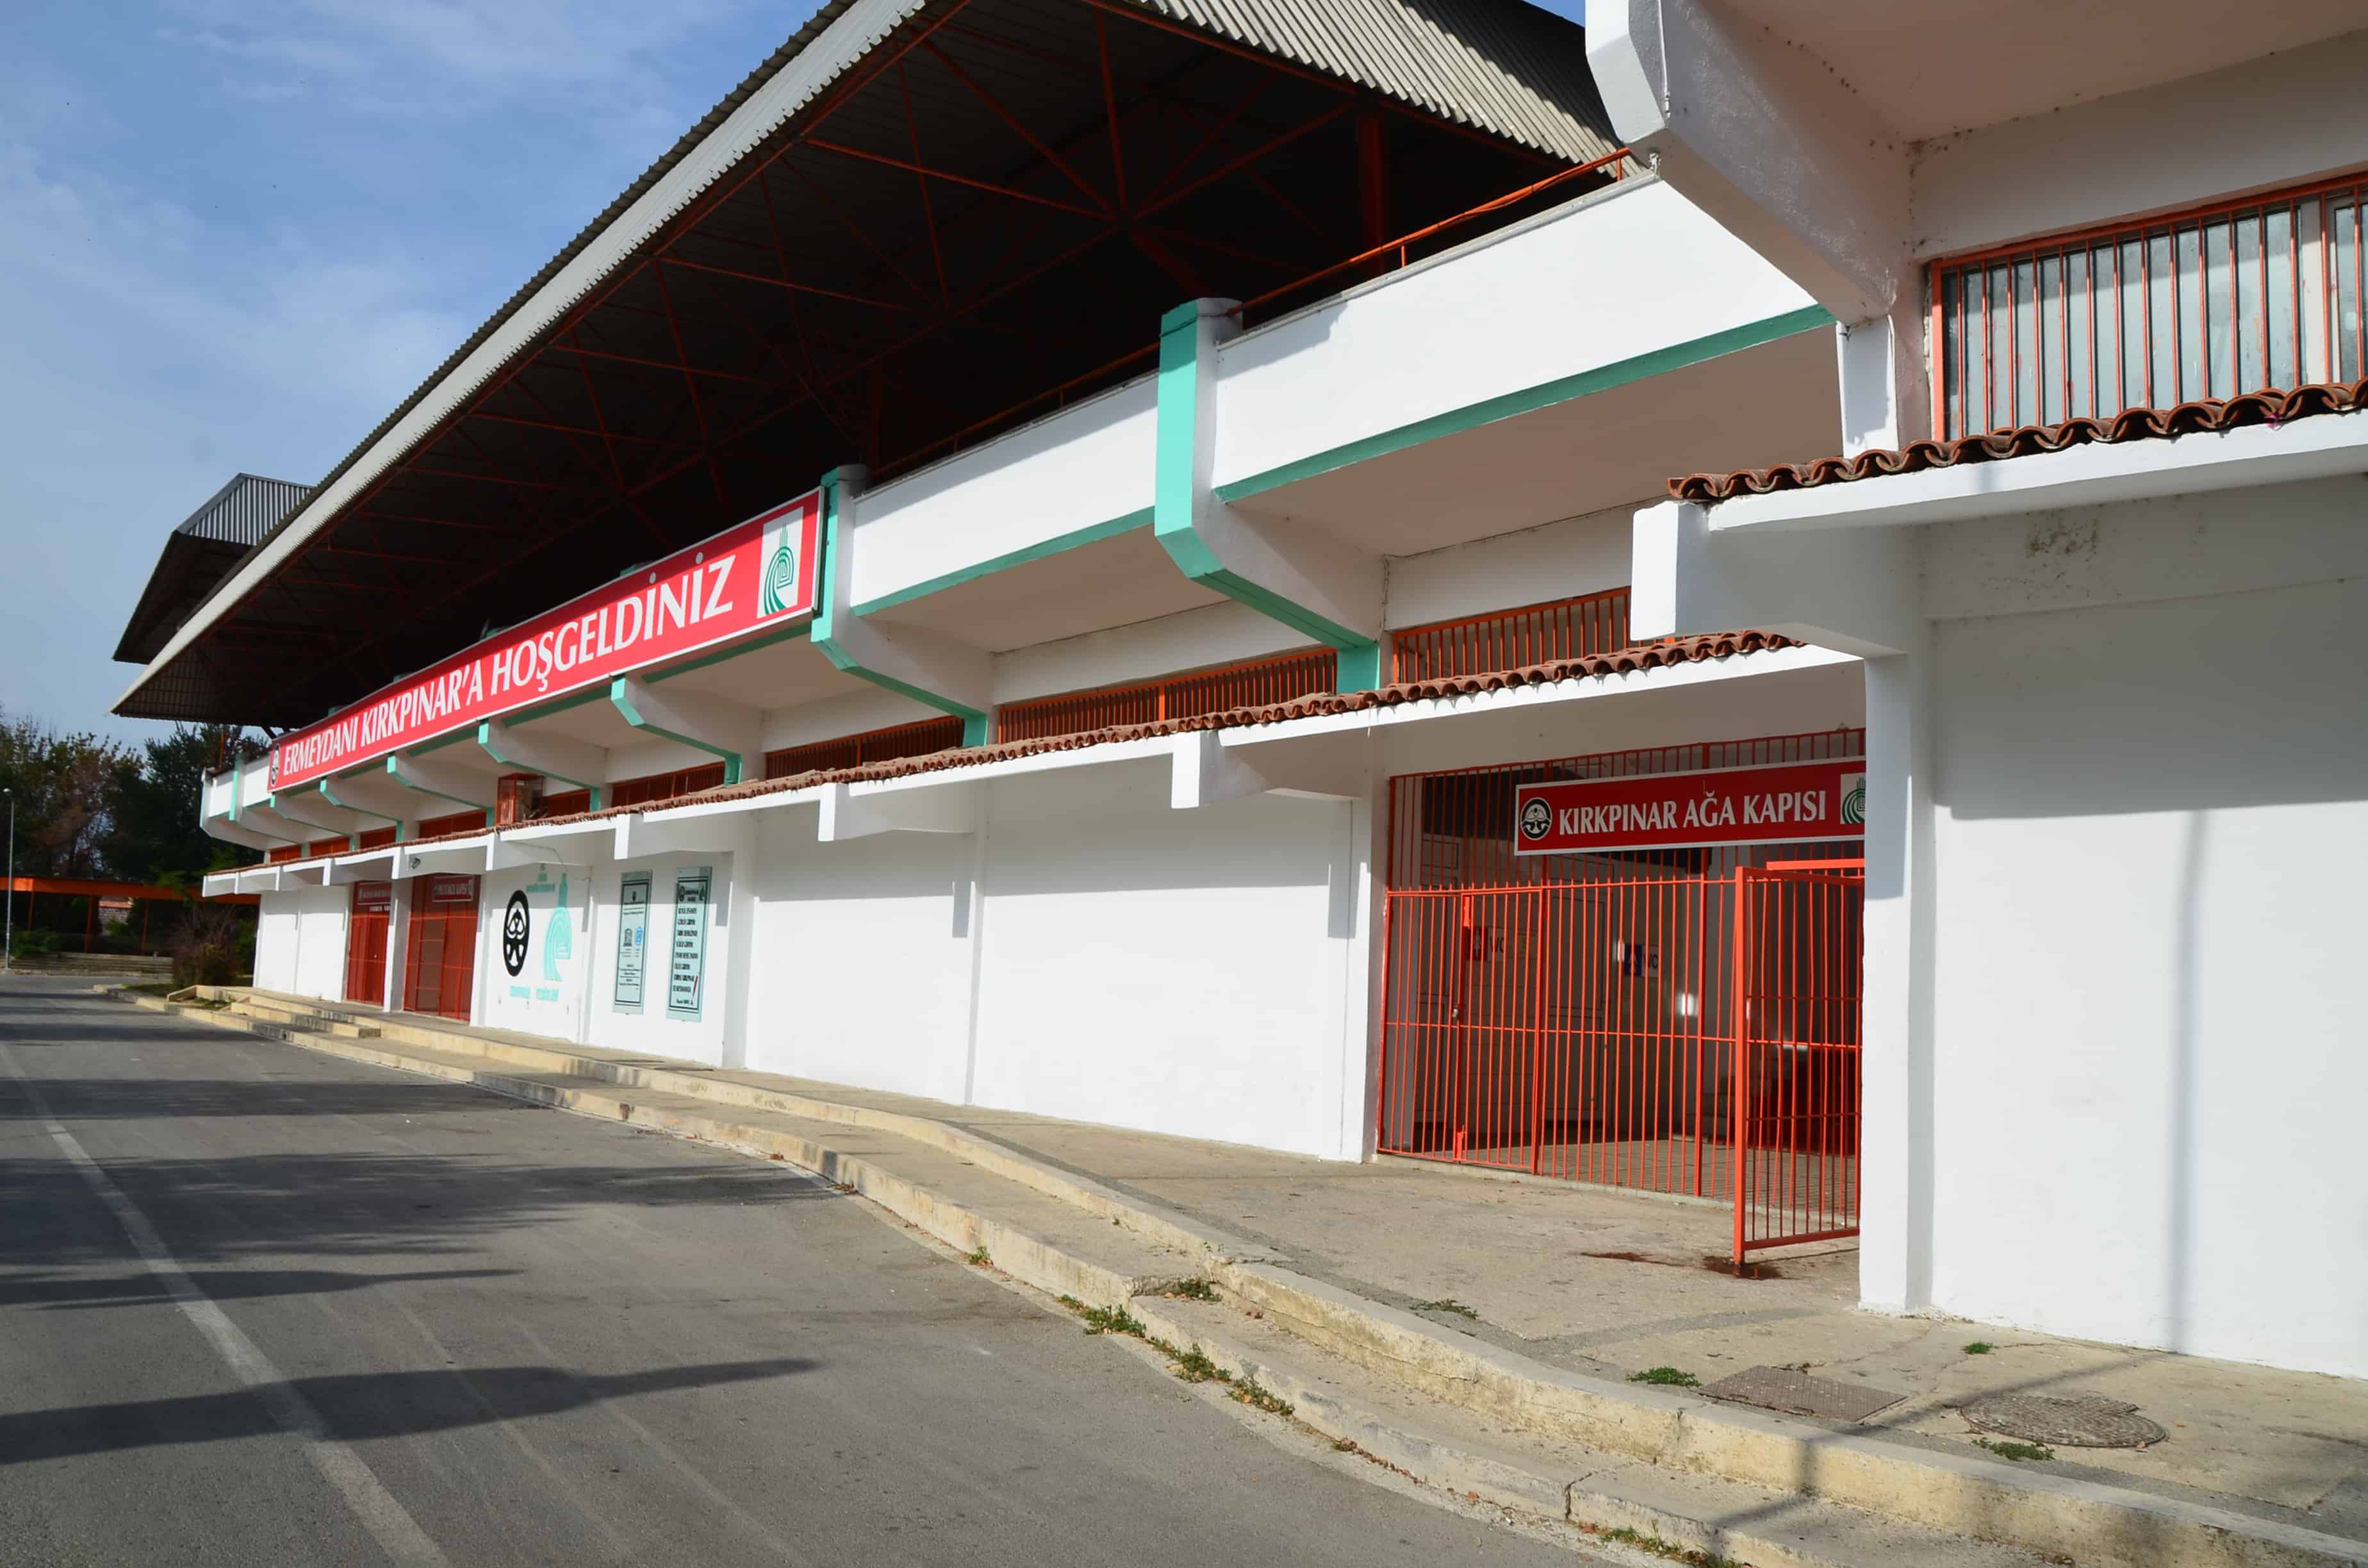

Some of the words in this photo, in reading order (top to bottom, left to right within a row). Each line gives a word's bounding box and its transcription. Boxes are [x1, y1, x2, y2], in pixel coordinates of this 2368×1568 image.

[283, 717, 359, 776] ERMEYDANI
[360, 658, 484, 747] KIRKPINAR'A
[490, 551, 736, 692] HOŞGELDİNİZ
[1559, 800, 1678, 836] KIRKPINAR
[1682, 790, 1736, 828] AĞA
[1743, 790, 1827, 825] KAPISI
